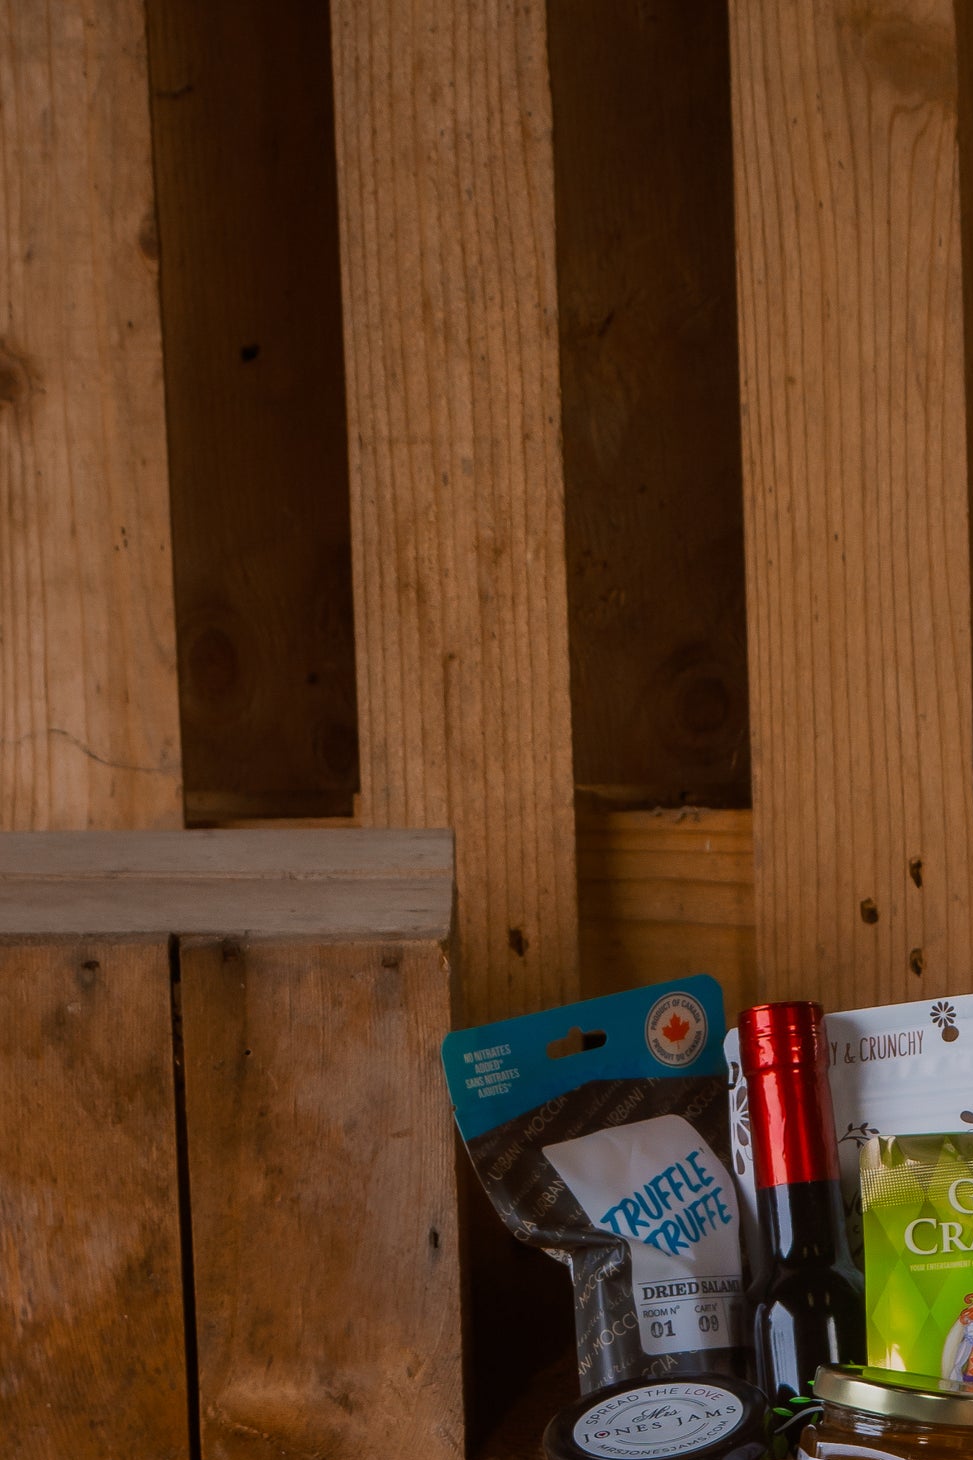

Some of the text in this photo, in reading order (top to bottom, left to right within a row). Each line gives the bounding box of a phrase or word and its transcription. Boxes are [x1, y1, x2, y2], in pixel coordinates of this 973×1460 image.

[651, 999, 702, 1030] PRODUCT OF CANADA
[464, 1044, 511, 1064] NO NITRATES
[844, 1043, 855, 1064] &
[860, 1030, 924, 1062] CRUNCHY
[465, 1068, 520, 1089] SANS NITRATES
[488, 1143, 521, 1181] URBANI
[523, 1095, 569, 1143] MOCCIA
[532, 1178, 567, 1217] URBAN
[600, 1151, 714, 1236] TRUFFLE
[643, 1187, 732, 1257] TRUFFE
[642, 1282, 700, 1300] DRIED
[701, 1279, 740, 1294] SALAMI
[643, 1308, 668, 1318] ROOM
[650, 1320, 676, 1338] 01
[592, 1310, 640, 1355] MOCCI
[586, 1387, 724, 1425] SPREAD THE LOVE
[632, 1405, 680, 1423] Mrs
[583, 1405, 737, 1443] JONES JAMS
[597, 1420, 729, 1455] MRSJONESJAMS.COM
